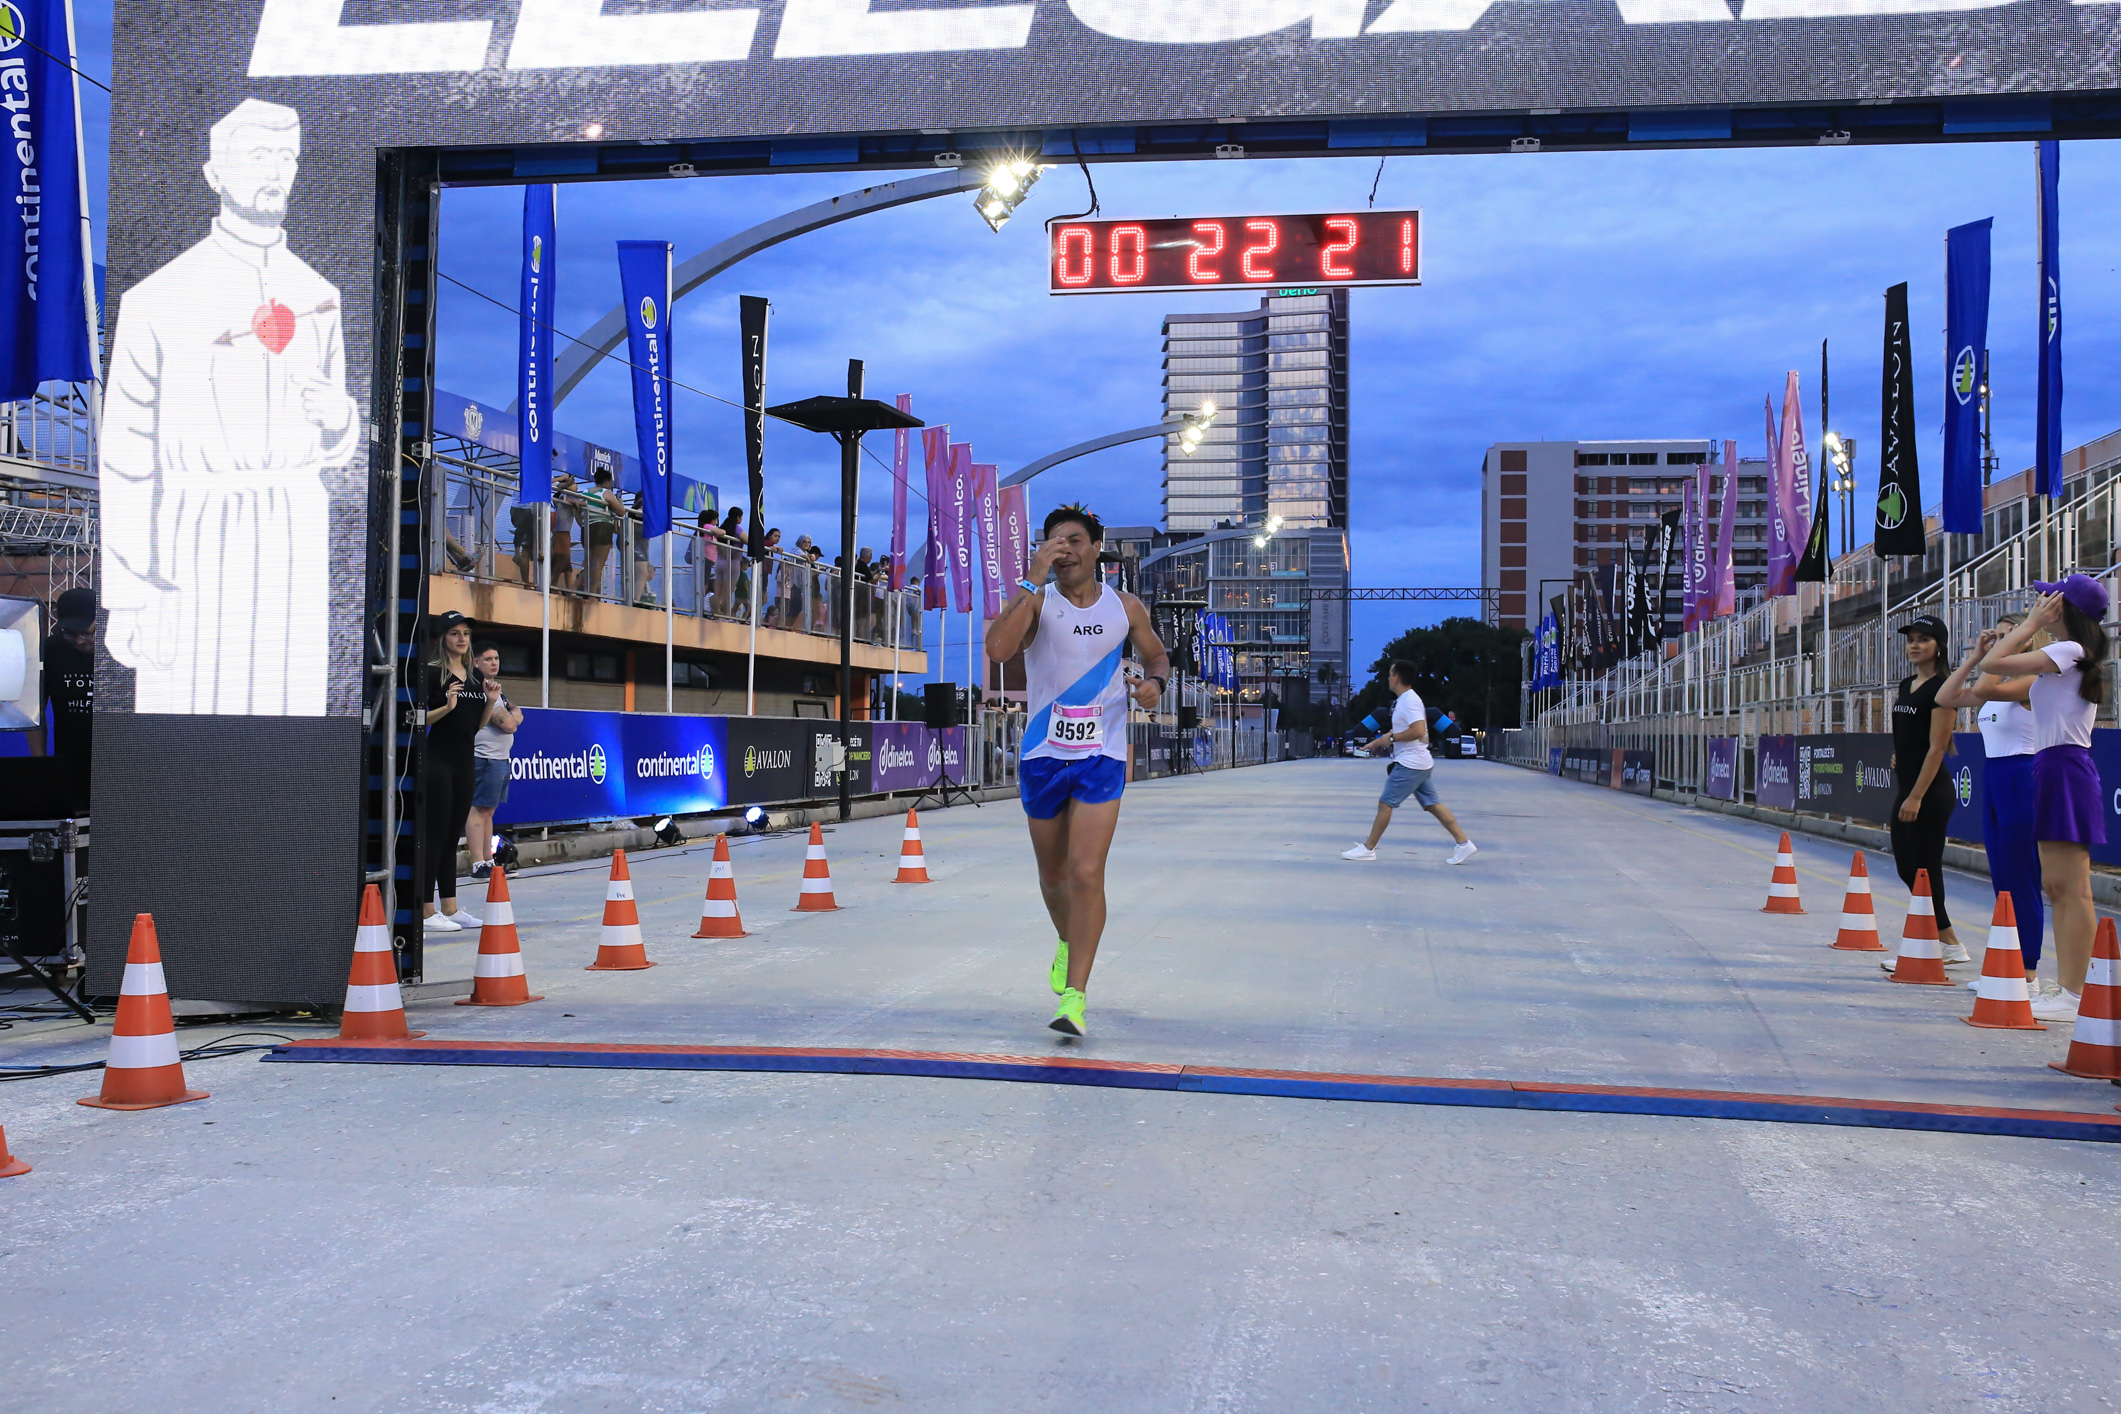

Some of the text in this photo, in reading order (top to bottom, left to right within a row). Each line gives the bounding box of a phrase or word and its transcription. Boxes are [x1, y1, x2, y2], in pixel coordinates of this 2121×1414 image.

[1058, 218, 1413, 285] 00 22 21
[645, 332, 667, 477] continental
[983, 492, 996, 560] dinelco.
[1626, 551, 1637, 620] OPPE
[1072, 624, 1104, 636] ARG
[1321, 591, 1331, 646] COSTANE
[68, 699, 94, 708] HILF
[1055, 719, 1096, 741] 9592
[636, 749, 700, 778] continental
[756, 749, 792, 770] AVALON
[887, 743, 915, 769] dinelco.
[935, 744, 959, 766] dielco.
[1863, 766, 1892, 789] AVALON
